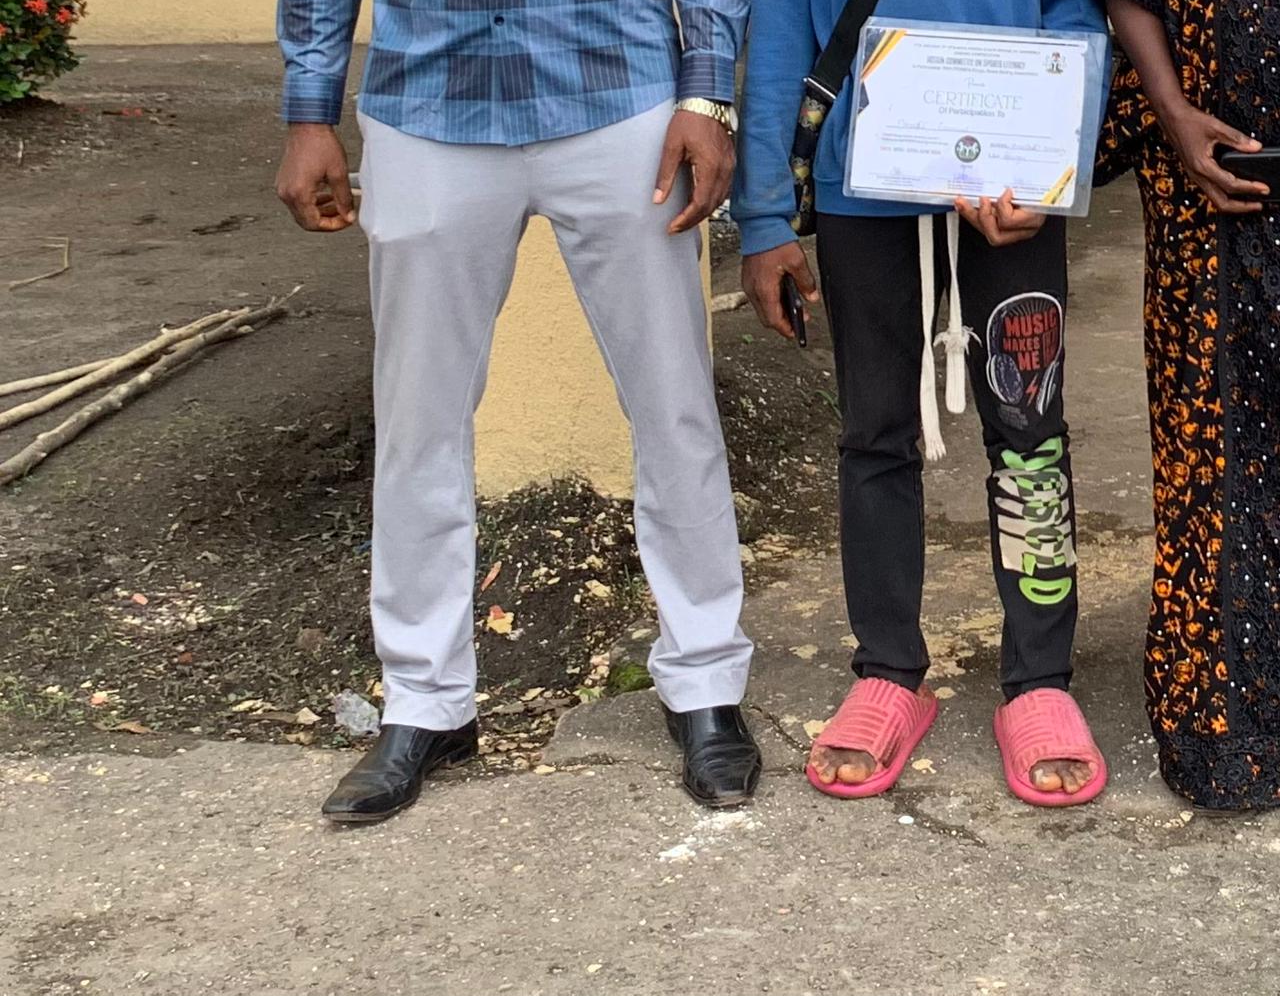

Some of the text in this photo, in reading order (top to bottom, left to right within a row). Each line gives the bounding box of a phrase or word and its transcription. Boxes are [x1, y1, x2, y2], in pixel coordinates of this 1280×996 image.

[923, 89, 1024, 110] CERTIFICATE
[948, 107, 995, 117] Participation
[1004, 305, 1057, 337] MUSIC
[1003, 336, 1040, 351] MAKES
[1017, 350, 1041, 371] ME
